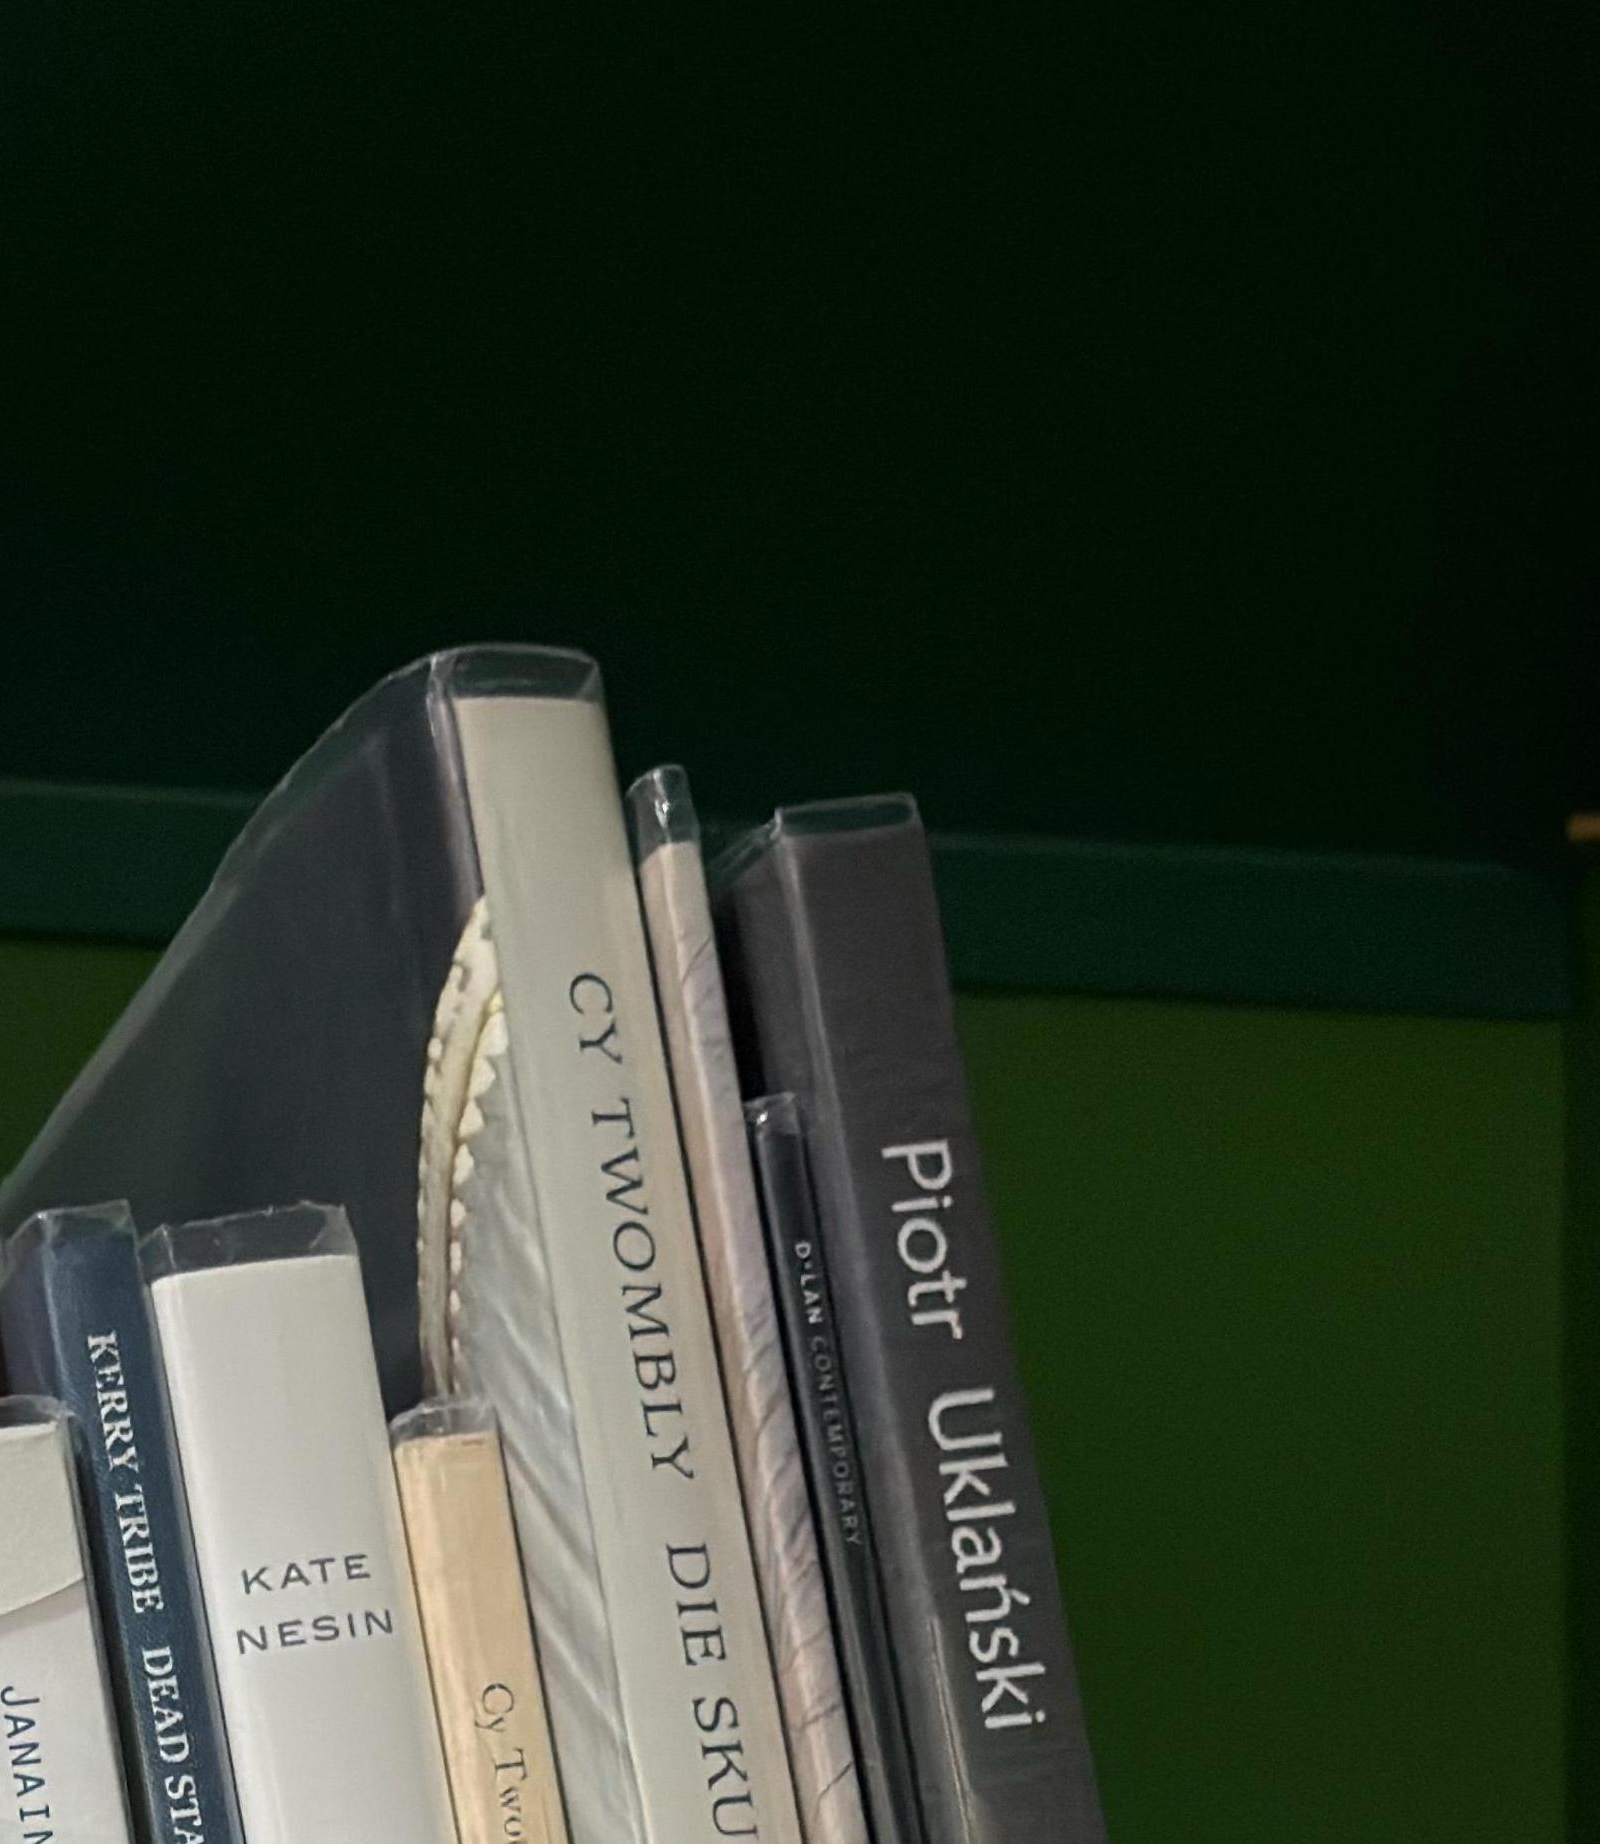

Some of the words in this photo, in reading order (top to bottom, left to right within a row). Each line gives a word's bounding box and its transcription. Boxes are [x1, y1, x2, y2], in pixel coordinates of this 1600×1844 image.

[570, 972, 623, 1065] CY
[591, 1100, 693, 1482] TWOMBLY
[810, 1336, 860, 1548] CONTEMPORARY
[881, 1138, 968, 1340] Piotr
[928, 1389, 1045, 1731] Uklański
[86, 1331, 141, 1474] KERRY
[114, 1484, 164, 1614] TRIBE
[142, 1645, 189, 1765] DEAD
[242, 1552, 372, 1596] KATE
[667, 1541, 726, 1667] DIE
[236, 1608, 394, 1656] NESIN
[474, 1681, 515, 1735] Cy
